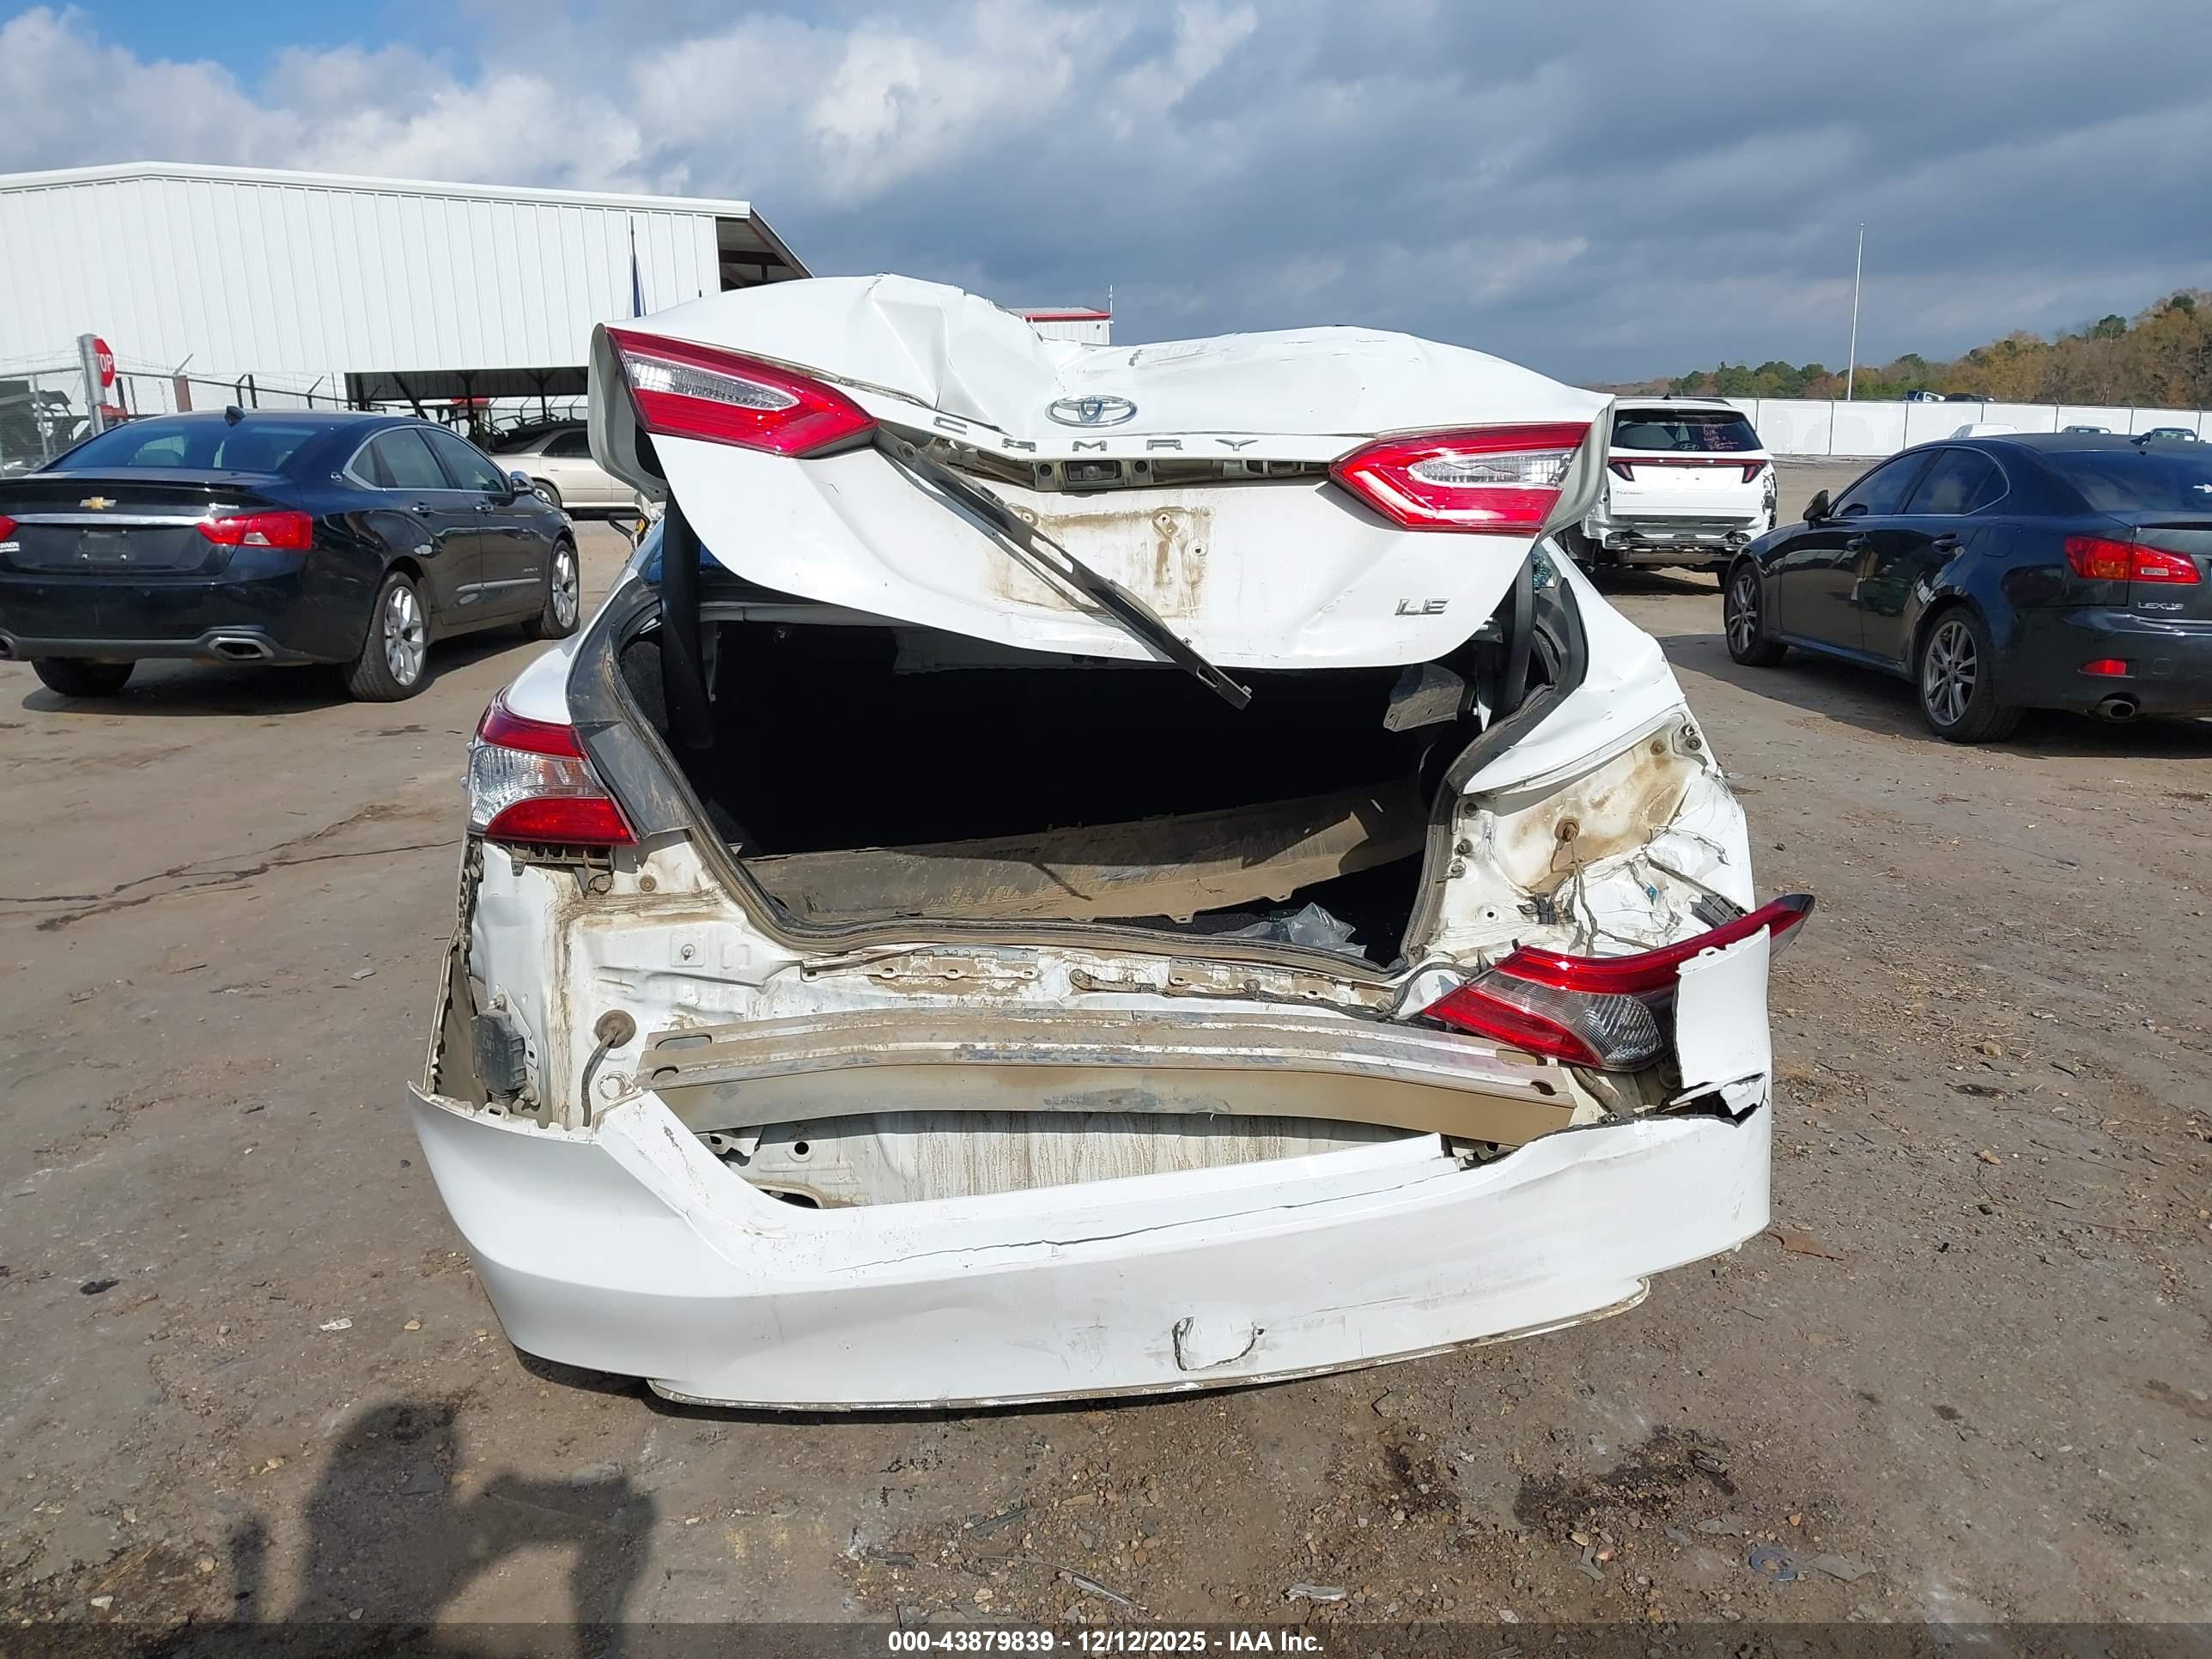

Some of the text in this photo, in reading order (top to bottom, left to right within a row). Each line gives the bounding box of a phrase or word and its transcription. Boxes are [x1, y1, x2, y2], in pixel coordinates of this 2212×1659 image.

[933, 416, 1260, 453] CAMRY
[1395, 599, 1449, 616] LE
[2136, 602, 2185, 611] LEXUS
